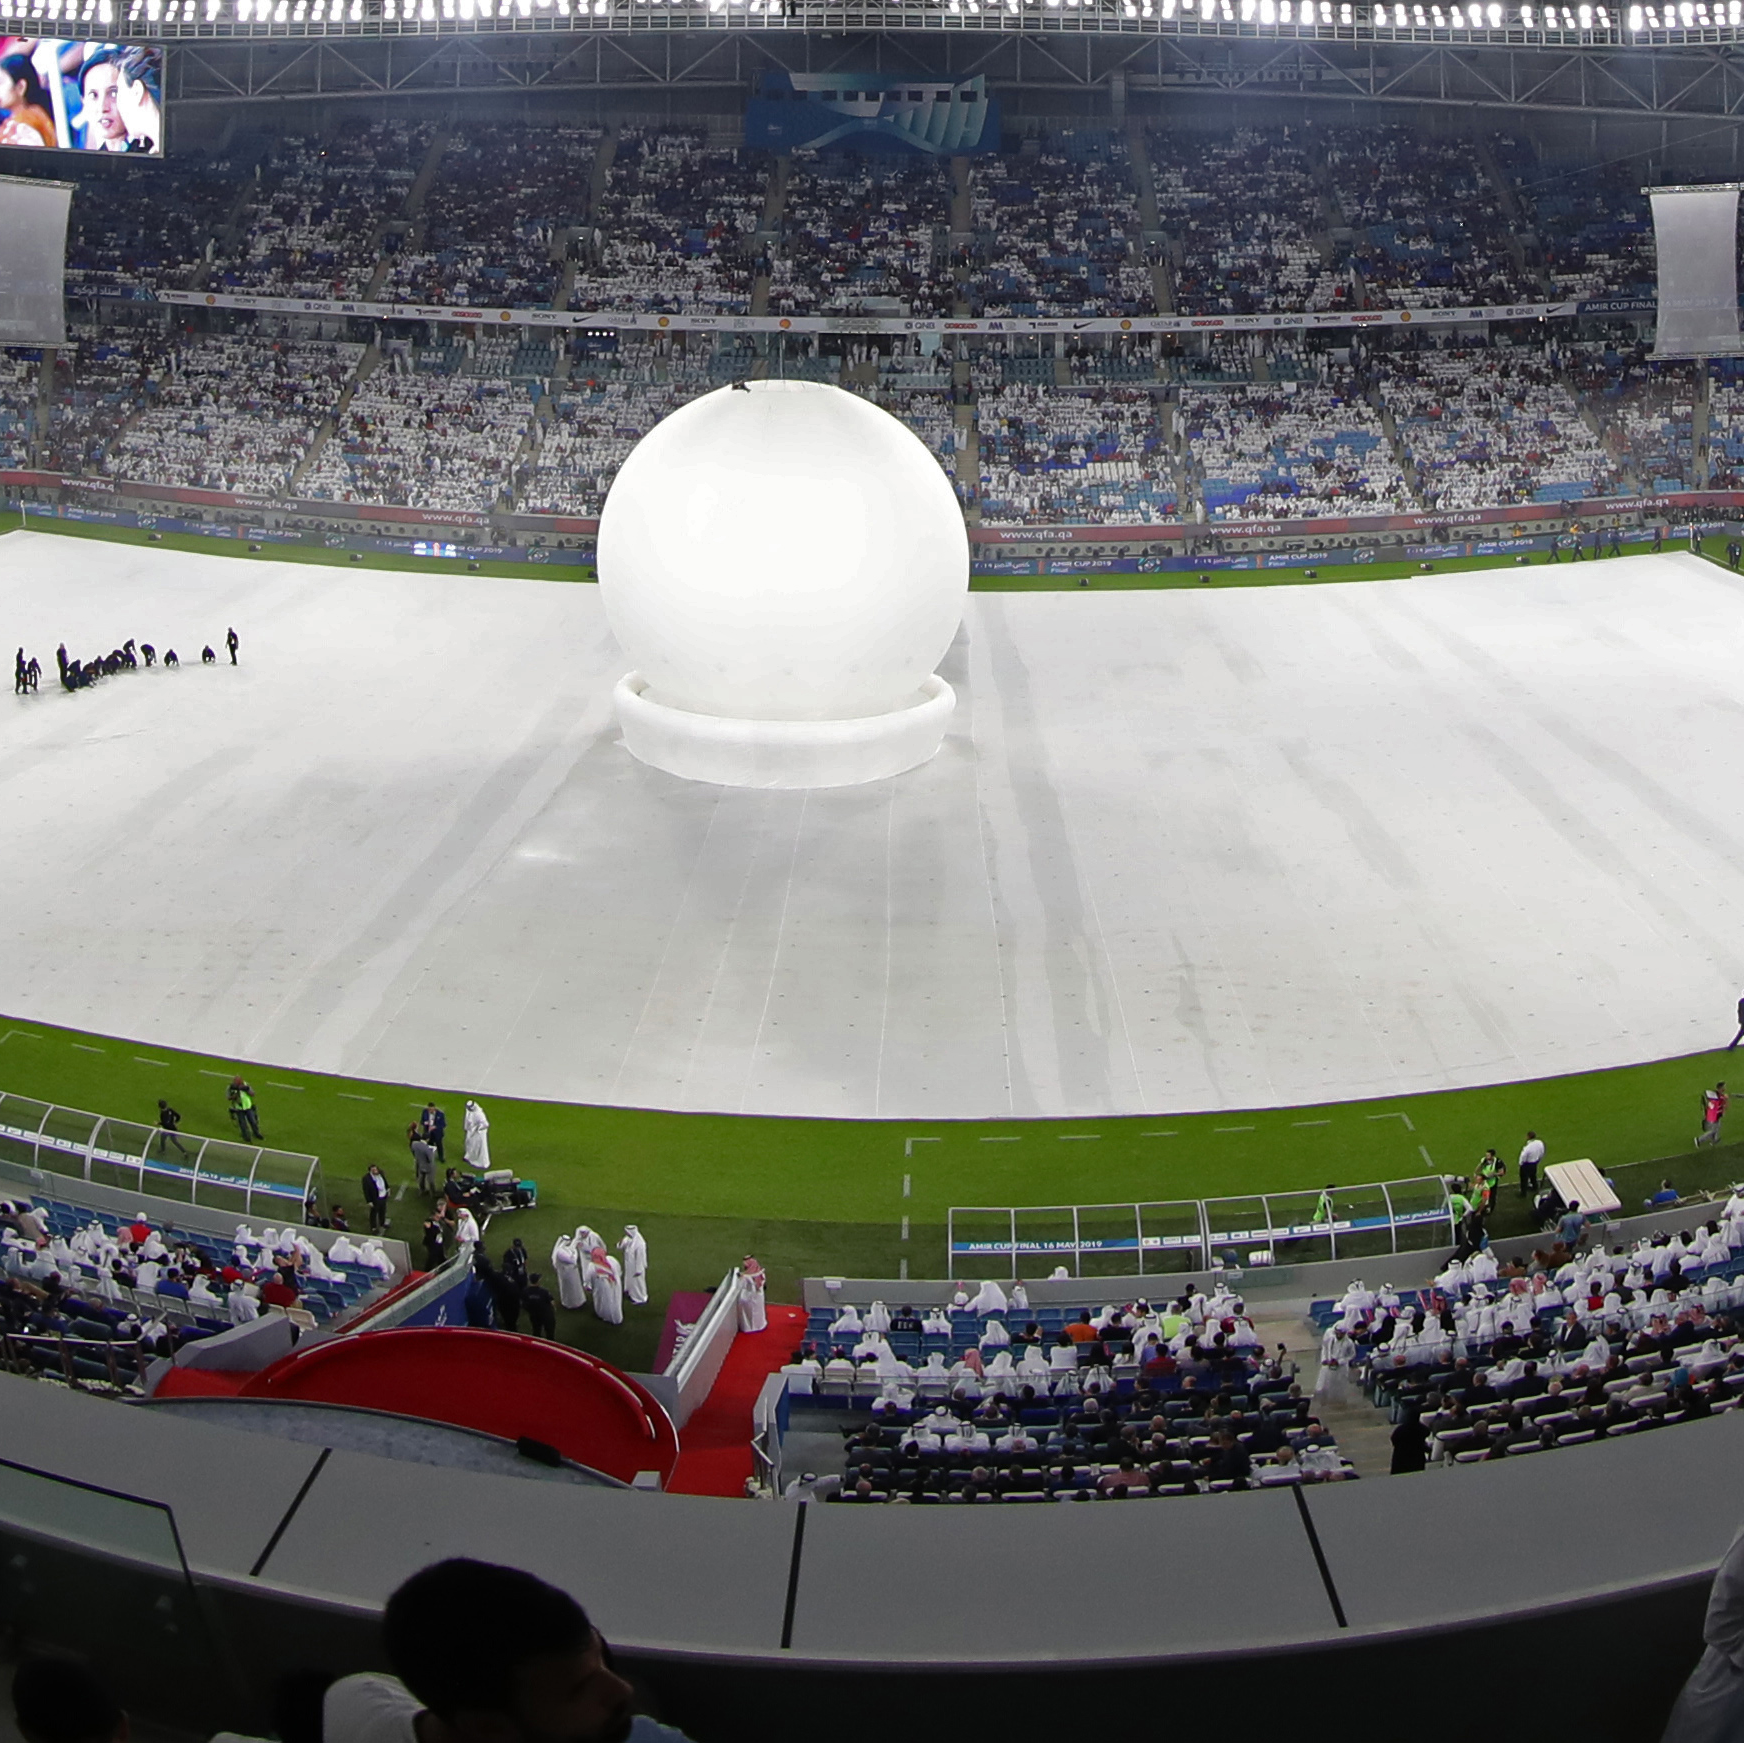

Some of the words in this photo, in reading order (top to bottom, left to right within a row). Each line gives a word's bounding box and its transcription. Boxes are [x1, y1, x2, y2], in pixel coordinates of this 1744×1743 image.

[1585, 302, 1608, 312] AMIR
[1611, 302, 1629, 311] CUP
[1631, 301, 1657, 310] FINAL
[915, 322, 935, 330] QNB
[1283, 317, 1303, 326] QNB
[235, 497, 298, 510] www.qfa.qa
[1606, 497, 1669, 511] www.qfa.qa
[422, 512, 490, 525] www.qfa.qa
[1414, 513, 1481, 526] www.qfa.qa
[1000, 530, 1073, 542] www.qfa.qa
[1210, 524, 1282, 537] www.qfa.qa
[1496, 540, 1511, 548] CUP
[1512, 538, 1533, 546] 2019
[1306, 552, 1328, 560] 2019
[1051, 560, 1071, 568] AMIR
[1072, 560, 1089, 568] CUP
[1055, 1241, 1076, 1249] MAY
